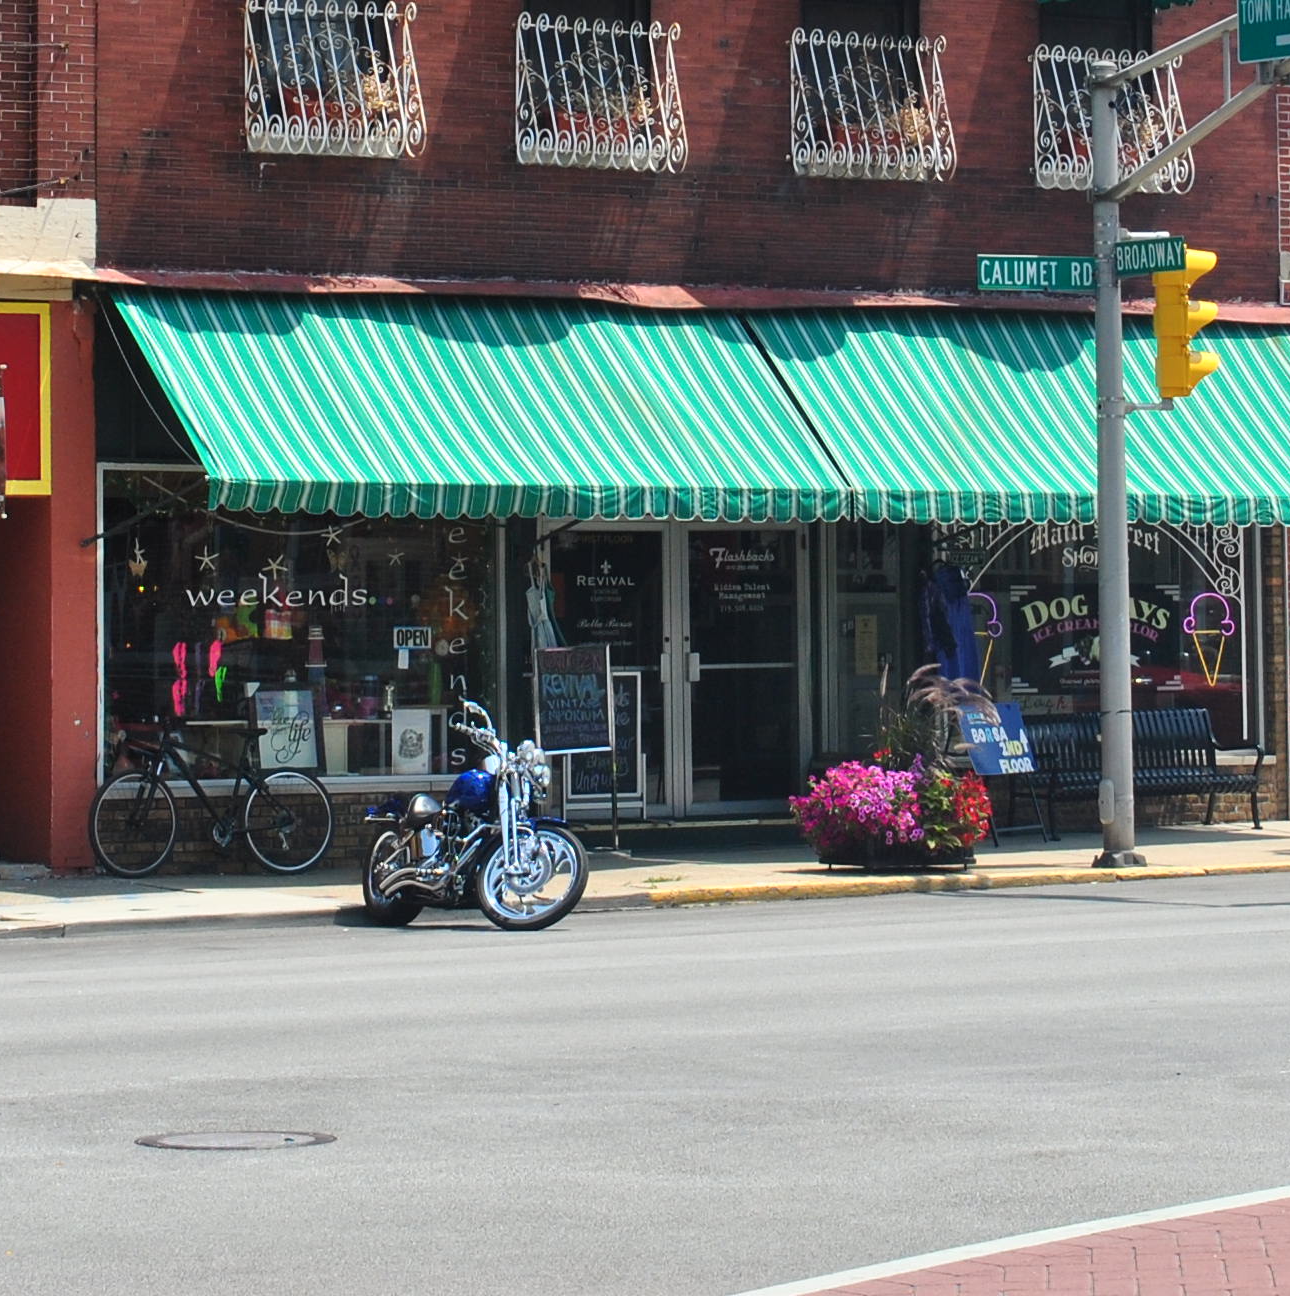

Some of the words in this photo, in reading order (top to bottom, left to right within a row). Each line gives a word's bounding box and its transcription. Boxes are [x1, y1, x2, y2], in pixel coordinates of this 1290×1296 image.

[1116, 243, 1183, 271] BROADWAY
[980, 260, 1059, 286] CALUMET
[1071, 262, 1093, 286] RD
[709, 547, 775, 569] Flashbacks
[185, 573, 369, 608] weekends
[576, 575, 636, 586] REVIVAL
[1020, 593, 1089, 632] DOG
[1127, 597, 1170, 630] AYS
[395, 629, 429, 648] OPEN
[1032, 627, 1055, 644] ICE
[971, 726, 1009, 744] BORSA
[999, 757, 1035, 775] FLOOR
